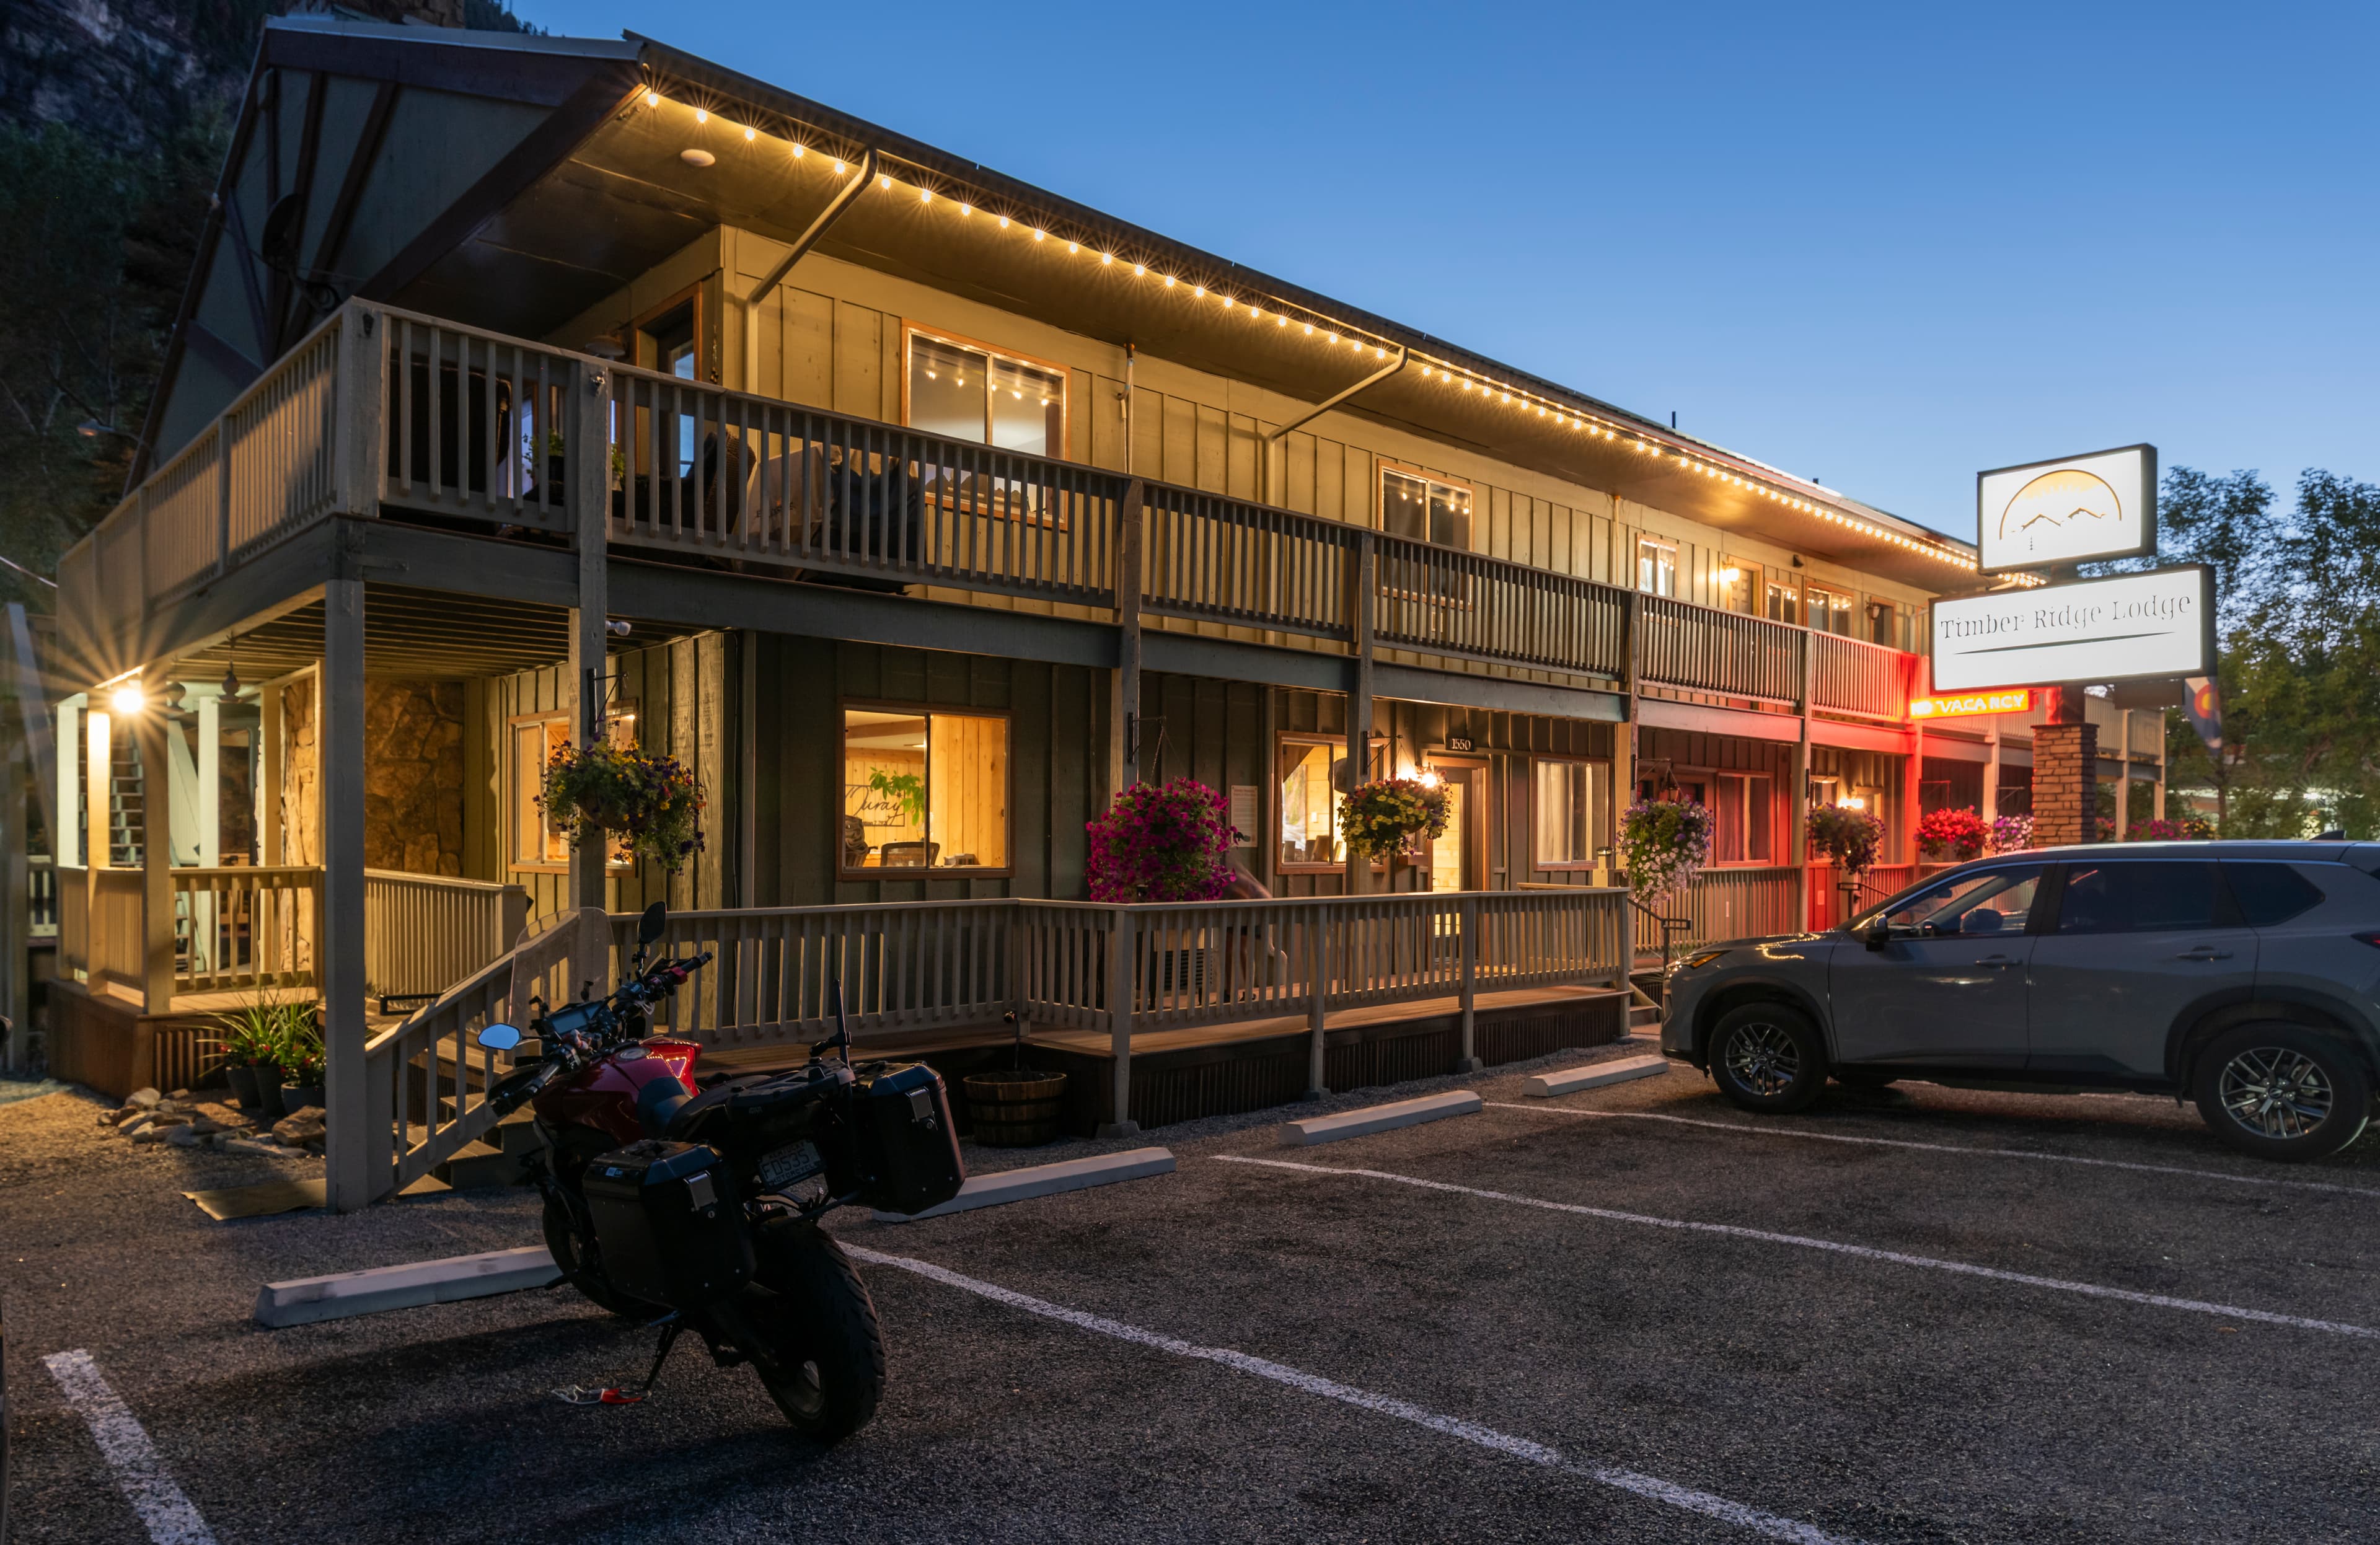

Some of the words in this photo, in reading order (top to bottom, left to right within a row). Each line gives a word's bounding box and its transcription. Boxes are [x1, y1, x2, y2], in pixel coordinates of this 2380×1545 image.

[1941, 614, 2024, 639] Timber
[2034, 605, 2101, 629] Ridge
[2112, 595, 2190, 620] Lodge
[1911, 701, 1932, 715] NO
[1936, 694, 2024, 713] VACANCY
[1452, 738, 1471, 750] 1550
